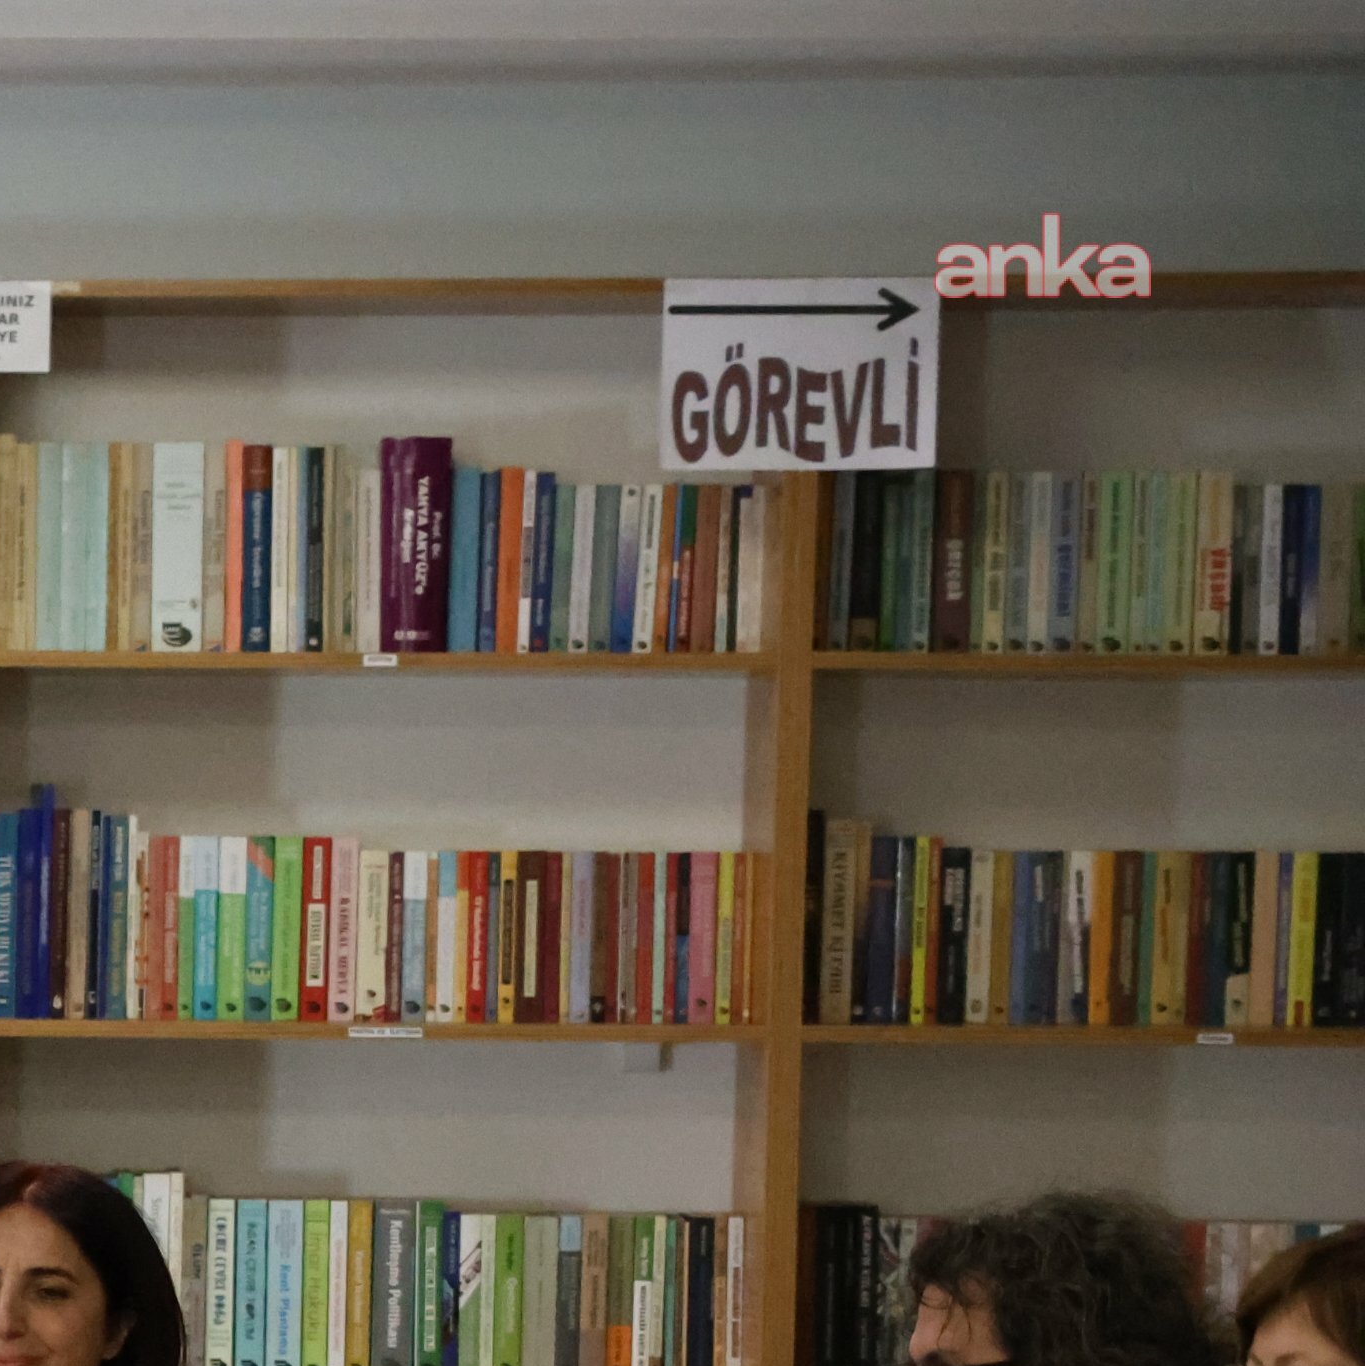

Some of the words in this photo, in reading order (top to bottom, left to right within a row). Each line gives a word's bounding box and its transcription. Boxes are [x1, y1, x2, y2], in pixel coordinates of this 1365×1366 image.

[672, 337, 920, 463] GÖREVLİ
[416, 476, 431, 526] YAHYA
[279, 1263, 292, 1292] Kent
[385, 1219, 404, 1287] Kentleşme
[386, 1288, 403, 1349] Politikası
